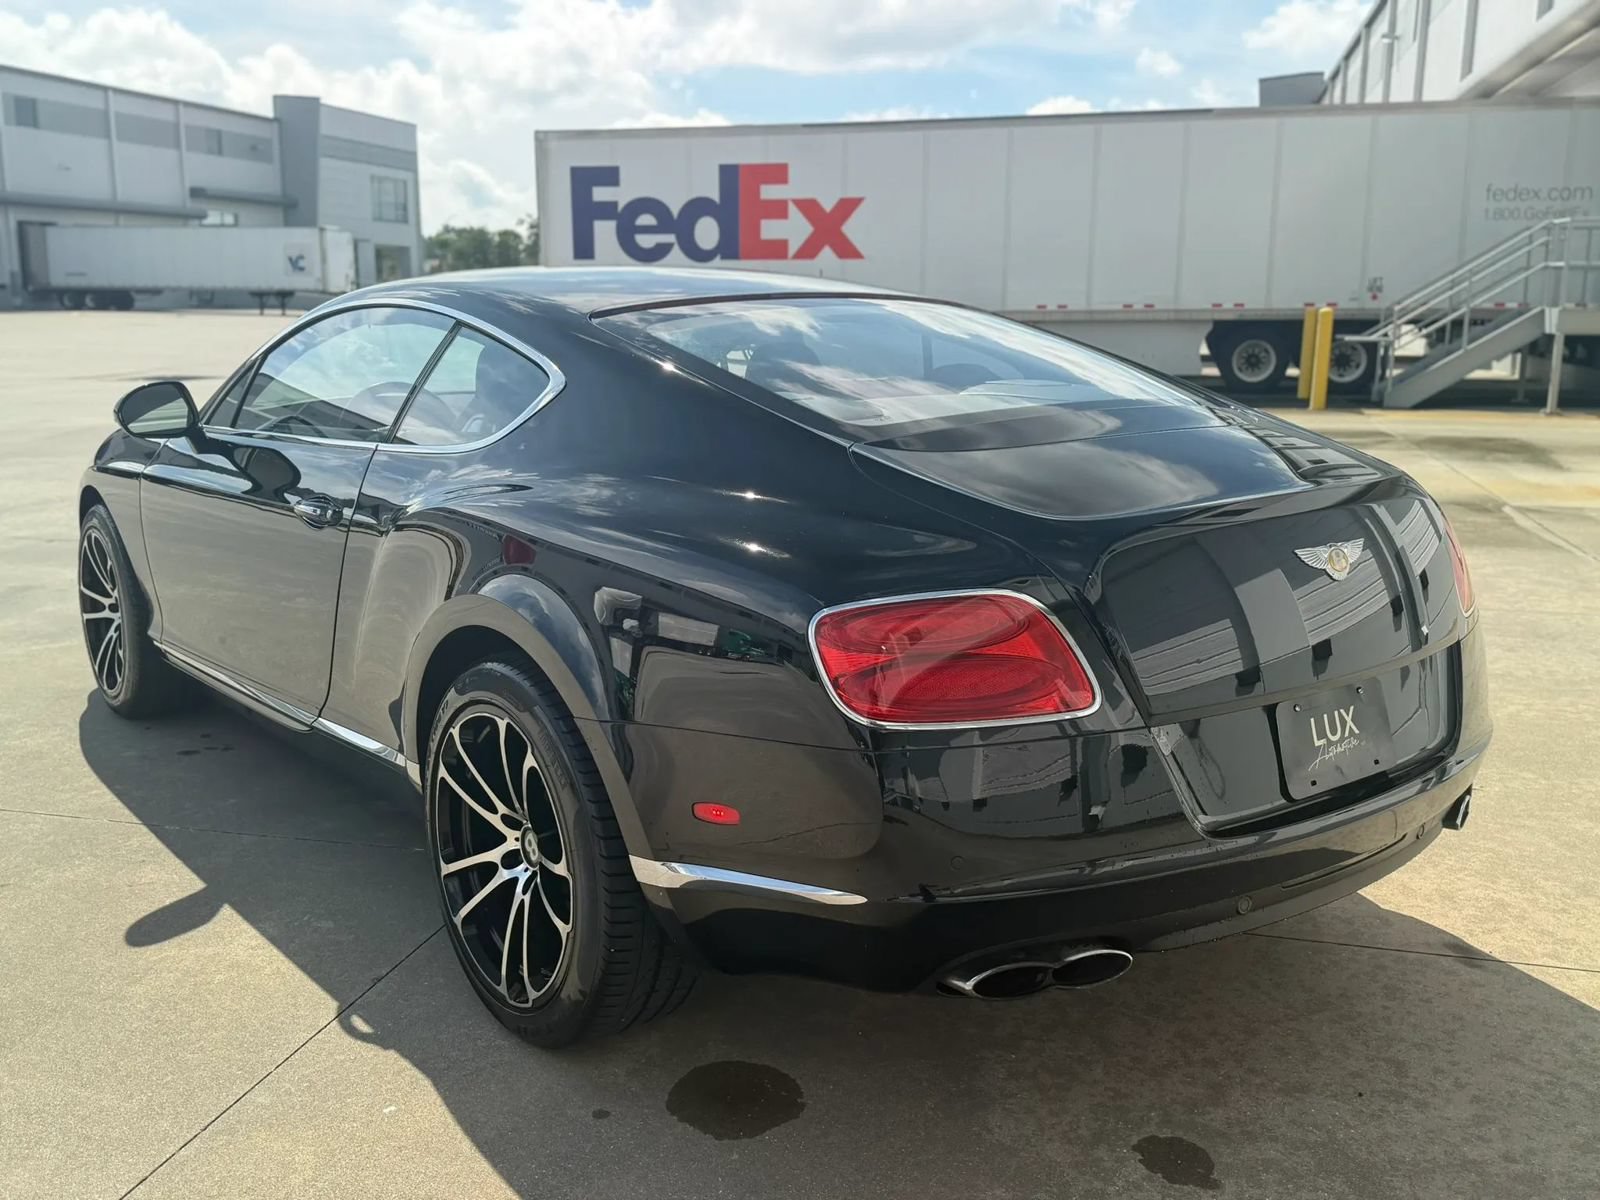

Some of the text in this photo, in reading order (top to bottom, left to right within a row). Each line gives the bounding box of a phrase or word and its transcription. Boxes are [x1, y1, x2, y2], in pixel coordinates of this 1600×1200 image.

[1485, 182, 1593, 202] fedex.com
[570, 163, 865, 263] FedEx
[1310, 705, 1359, 746] LUX
